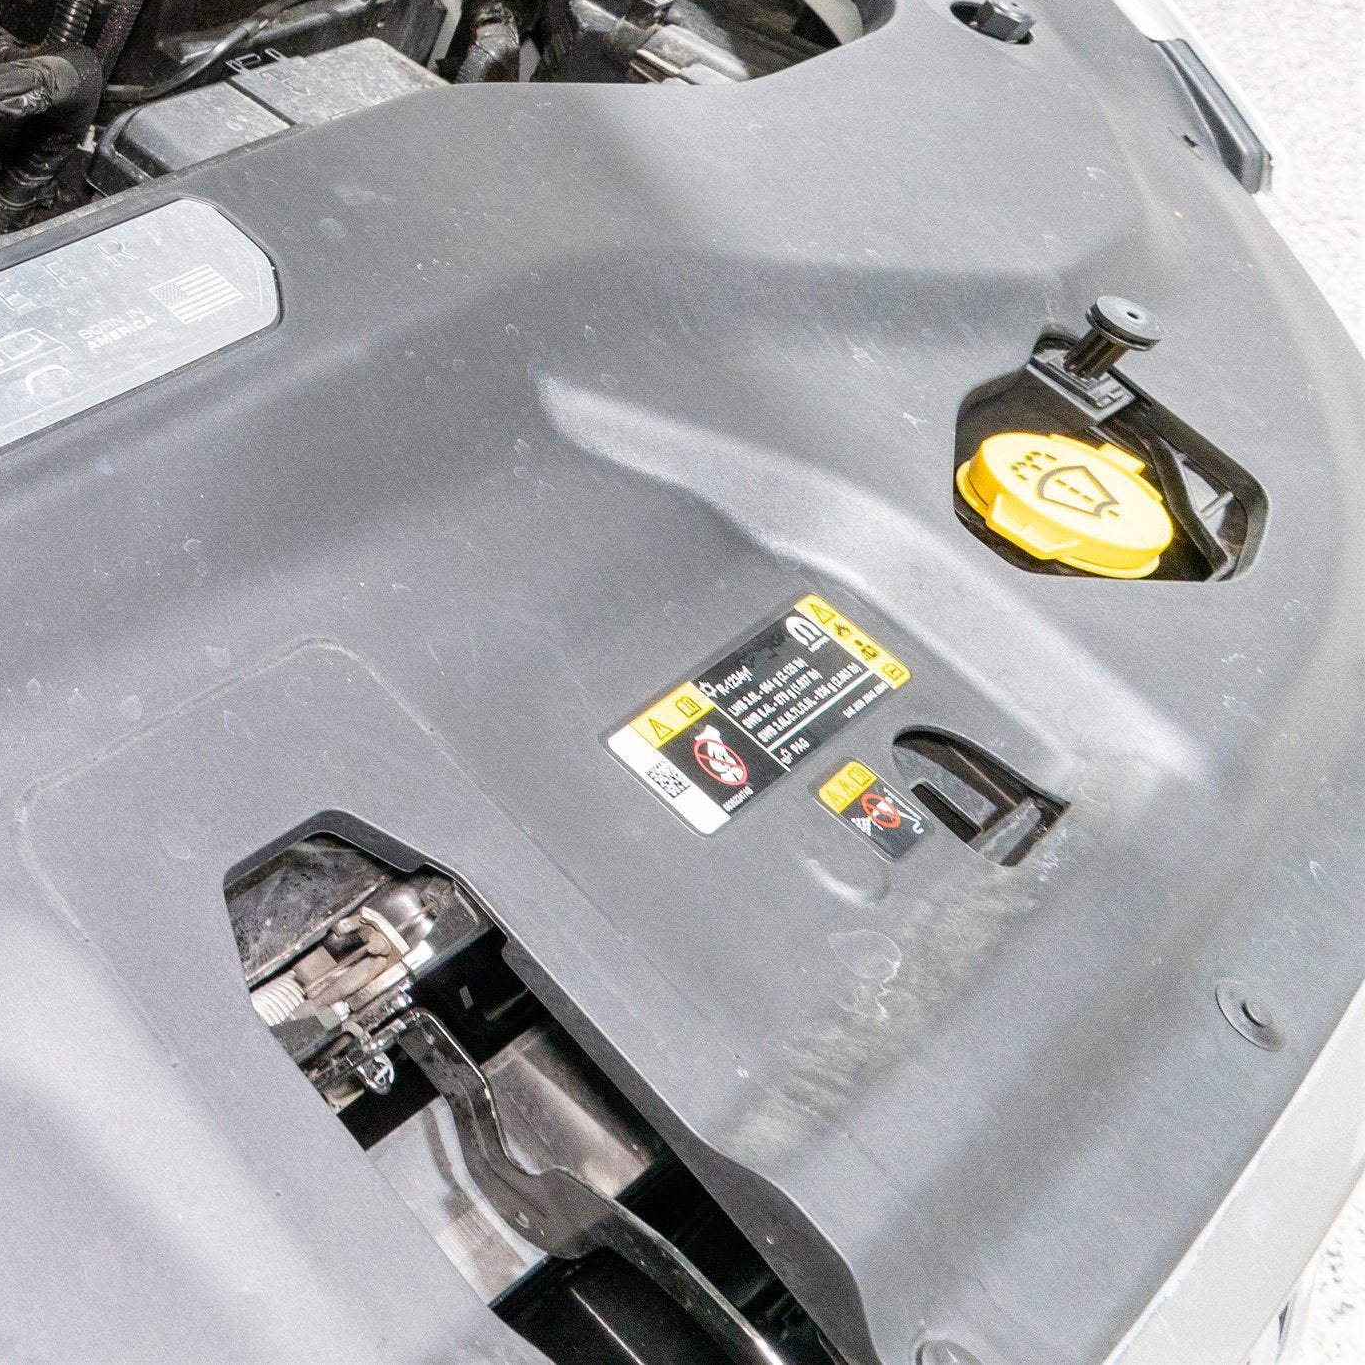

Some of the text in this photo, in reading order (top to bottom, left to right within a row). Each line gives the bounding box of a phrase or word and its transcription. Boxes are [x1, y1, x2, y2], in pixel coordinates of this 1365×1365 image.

[78, 306, 145, 340] BORN IN
[85, 315, 157, 351] AMERICA
[715, 665, 753, 696] R-1234yf
[728, 699, 748, 717] LWB
[742, 711, 763, 729] SWB
[757, 725, 778, 743] SWB
[790, 737, 810, 755] PAG
